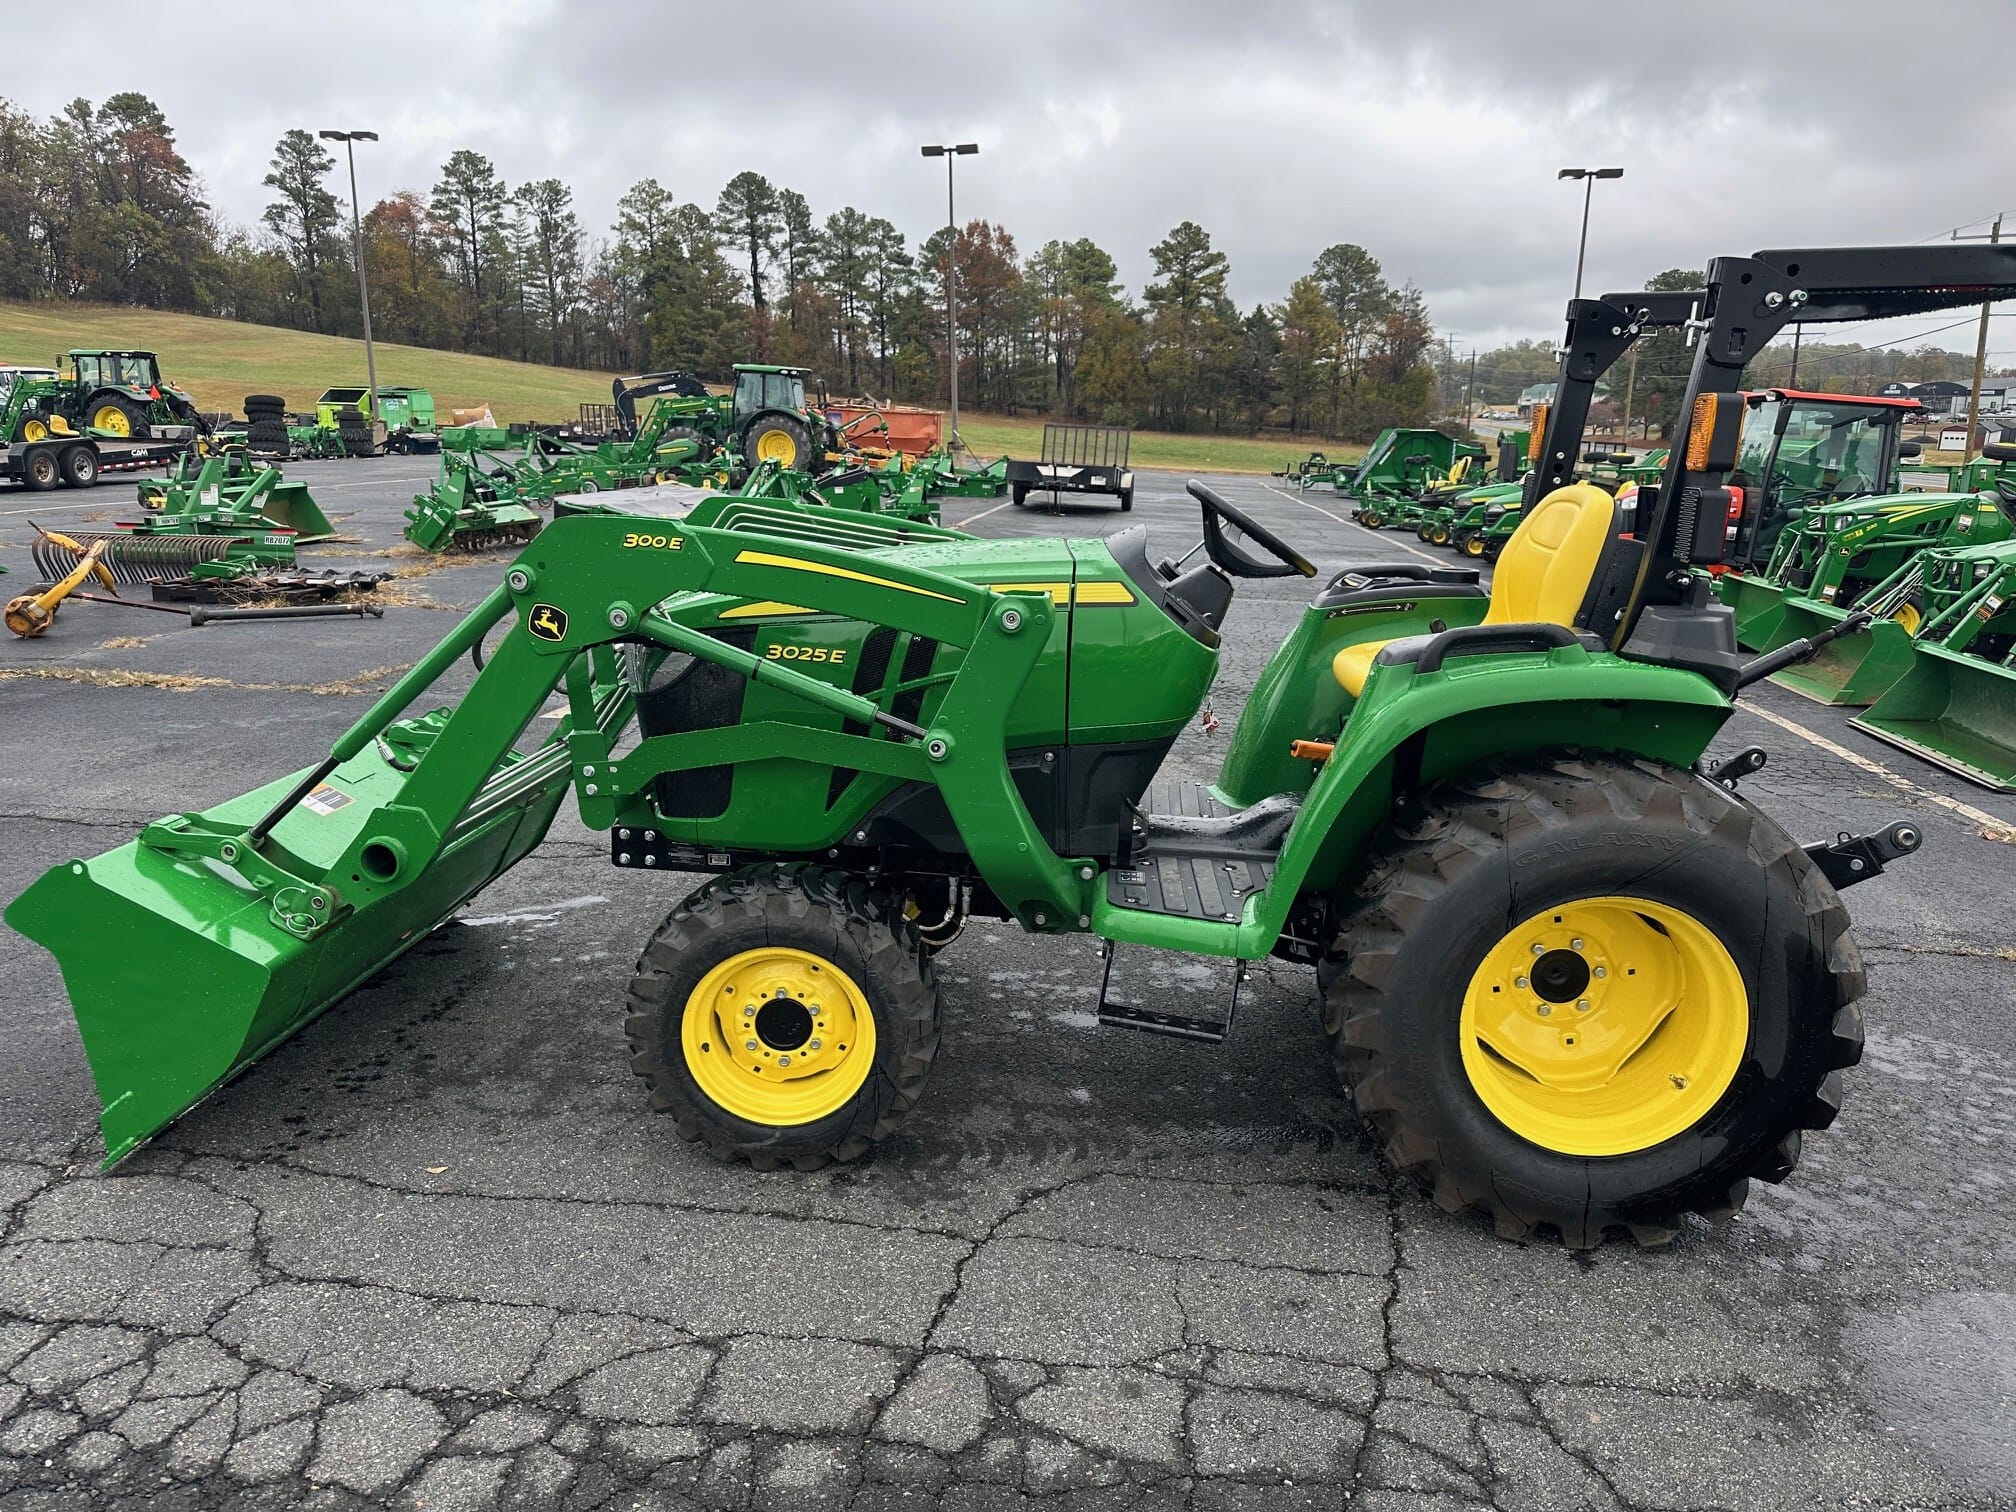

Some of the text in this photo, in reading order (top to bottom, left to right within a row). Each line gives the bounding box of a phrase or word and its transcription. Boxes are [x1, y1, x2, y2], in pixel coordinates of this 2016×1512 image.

[657, 383, 677, 392] DEERE
[131, 448, 148, 457] CAM
[1514, 832, 1683, 868] GALAXY
